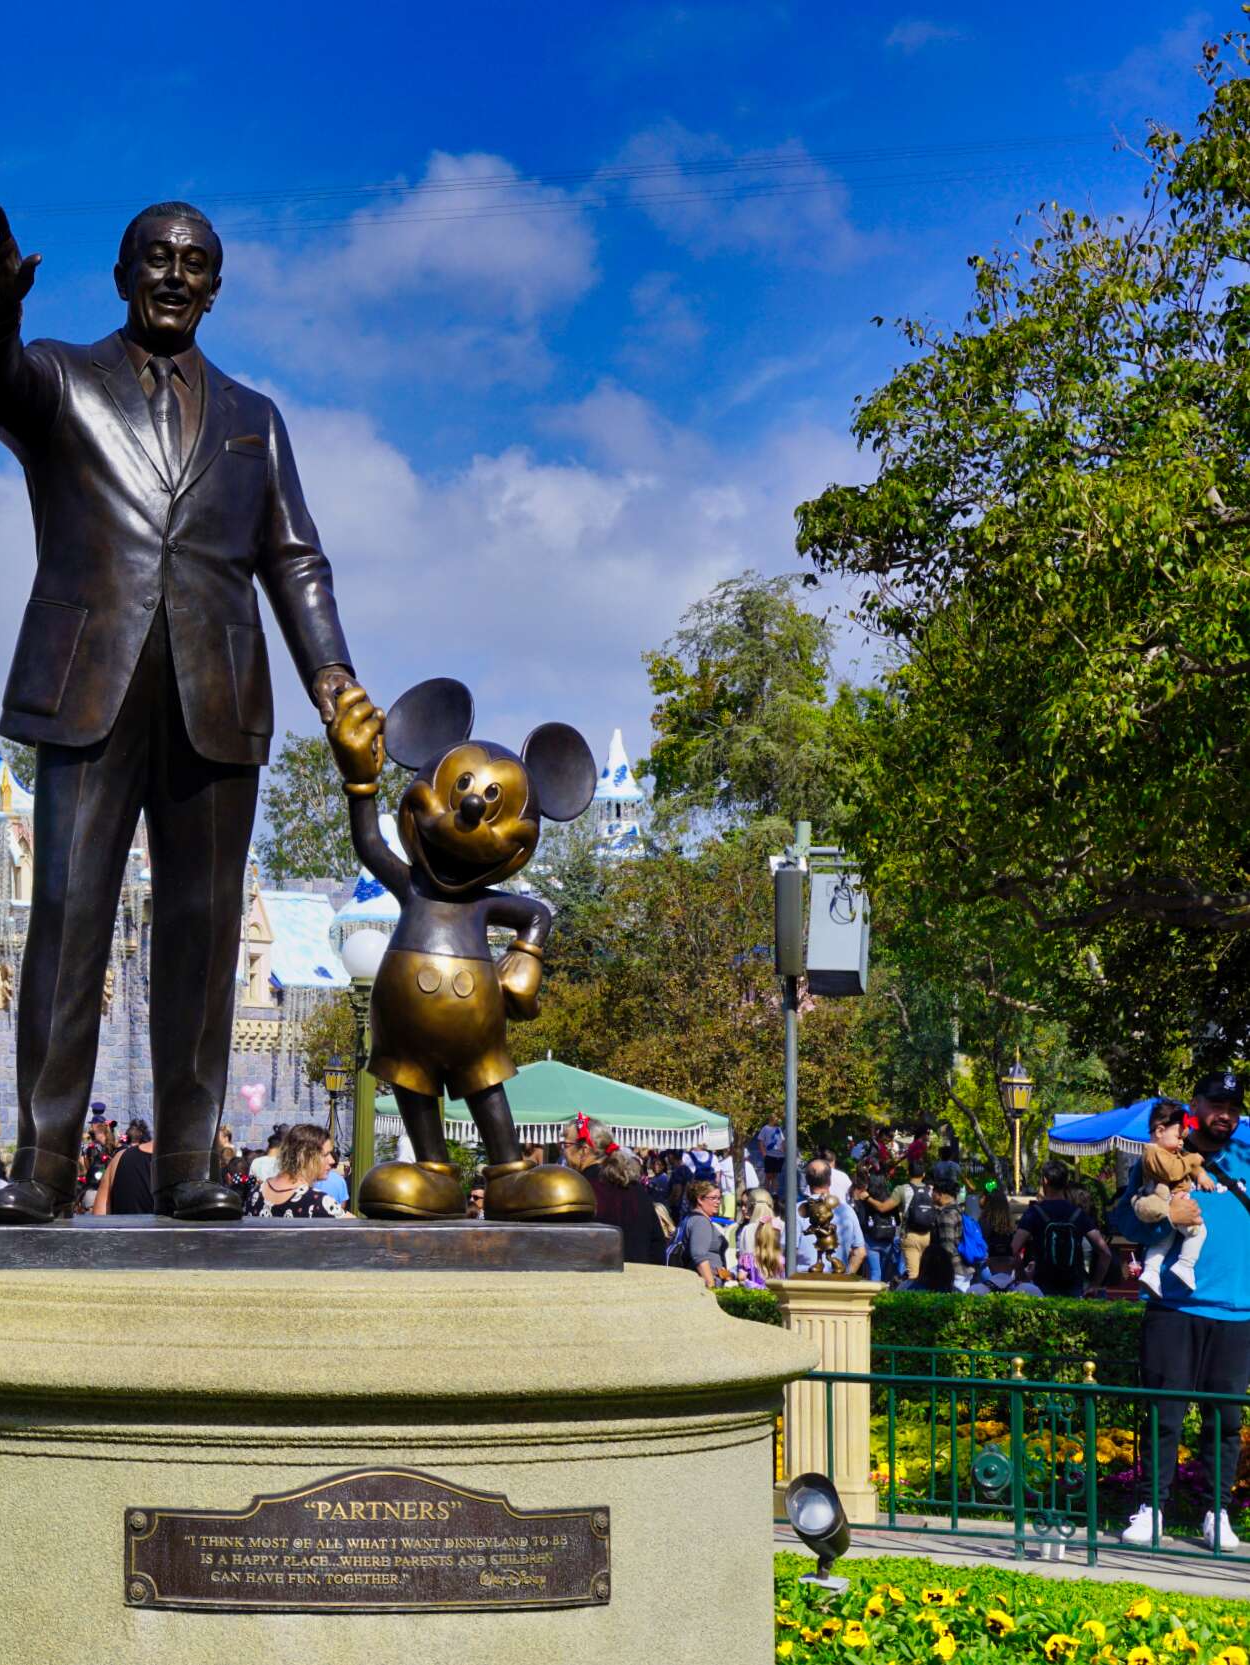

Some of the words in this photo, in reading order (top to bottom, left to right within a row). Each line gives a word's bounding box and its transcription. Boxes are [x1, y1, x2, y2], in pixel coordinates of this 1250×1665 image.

[201, 1536, 244, 1548] THINK
[249, 1537, 288, 1548] MOST
[293, 1538, 312, 1549] OF
[317, 1539, 342, 1549] ALL
[347, 1538, 385, 1549] WHAT
[391, 1538, 396, 1549] I
[400, 1538, 440, 1549] WANT
[445, 1536, 528, 1549] DISNEYLAND
[533, 1535, 548, 1547] TO
[552, 1535, 567, 1546] BE
[200, 1553, 213, 1565] IS
[218, 1555, 227, 1565] A
[232, 1555, 278, 1566] HAPPY
[394, 1556, 453, 1567] PARENTS
[458, 1555, 486, 1566] AND
[490, 1552, 554, 1565] CHILDREN
[211, 1571, 241, 1583] CAN
[246, 1573, 284, 1583] HAVE
